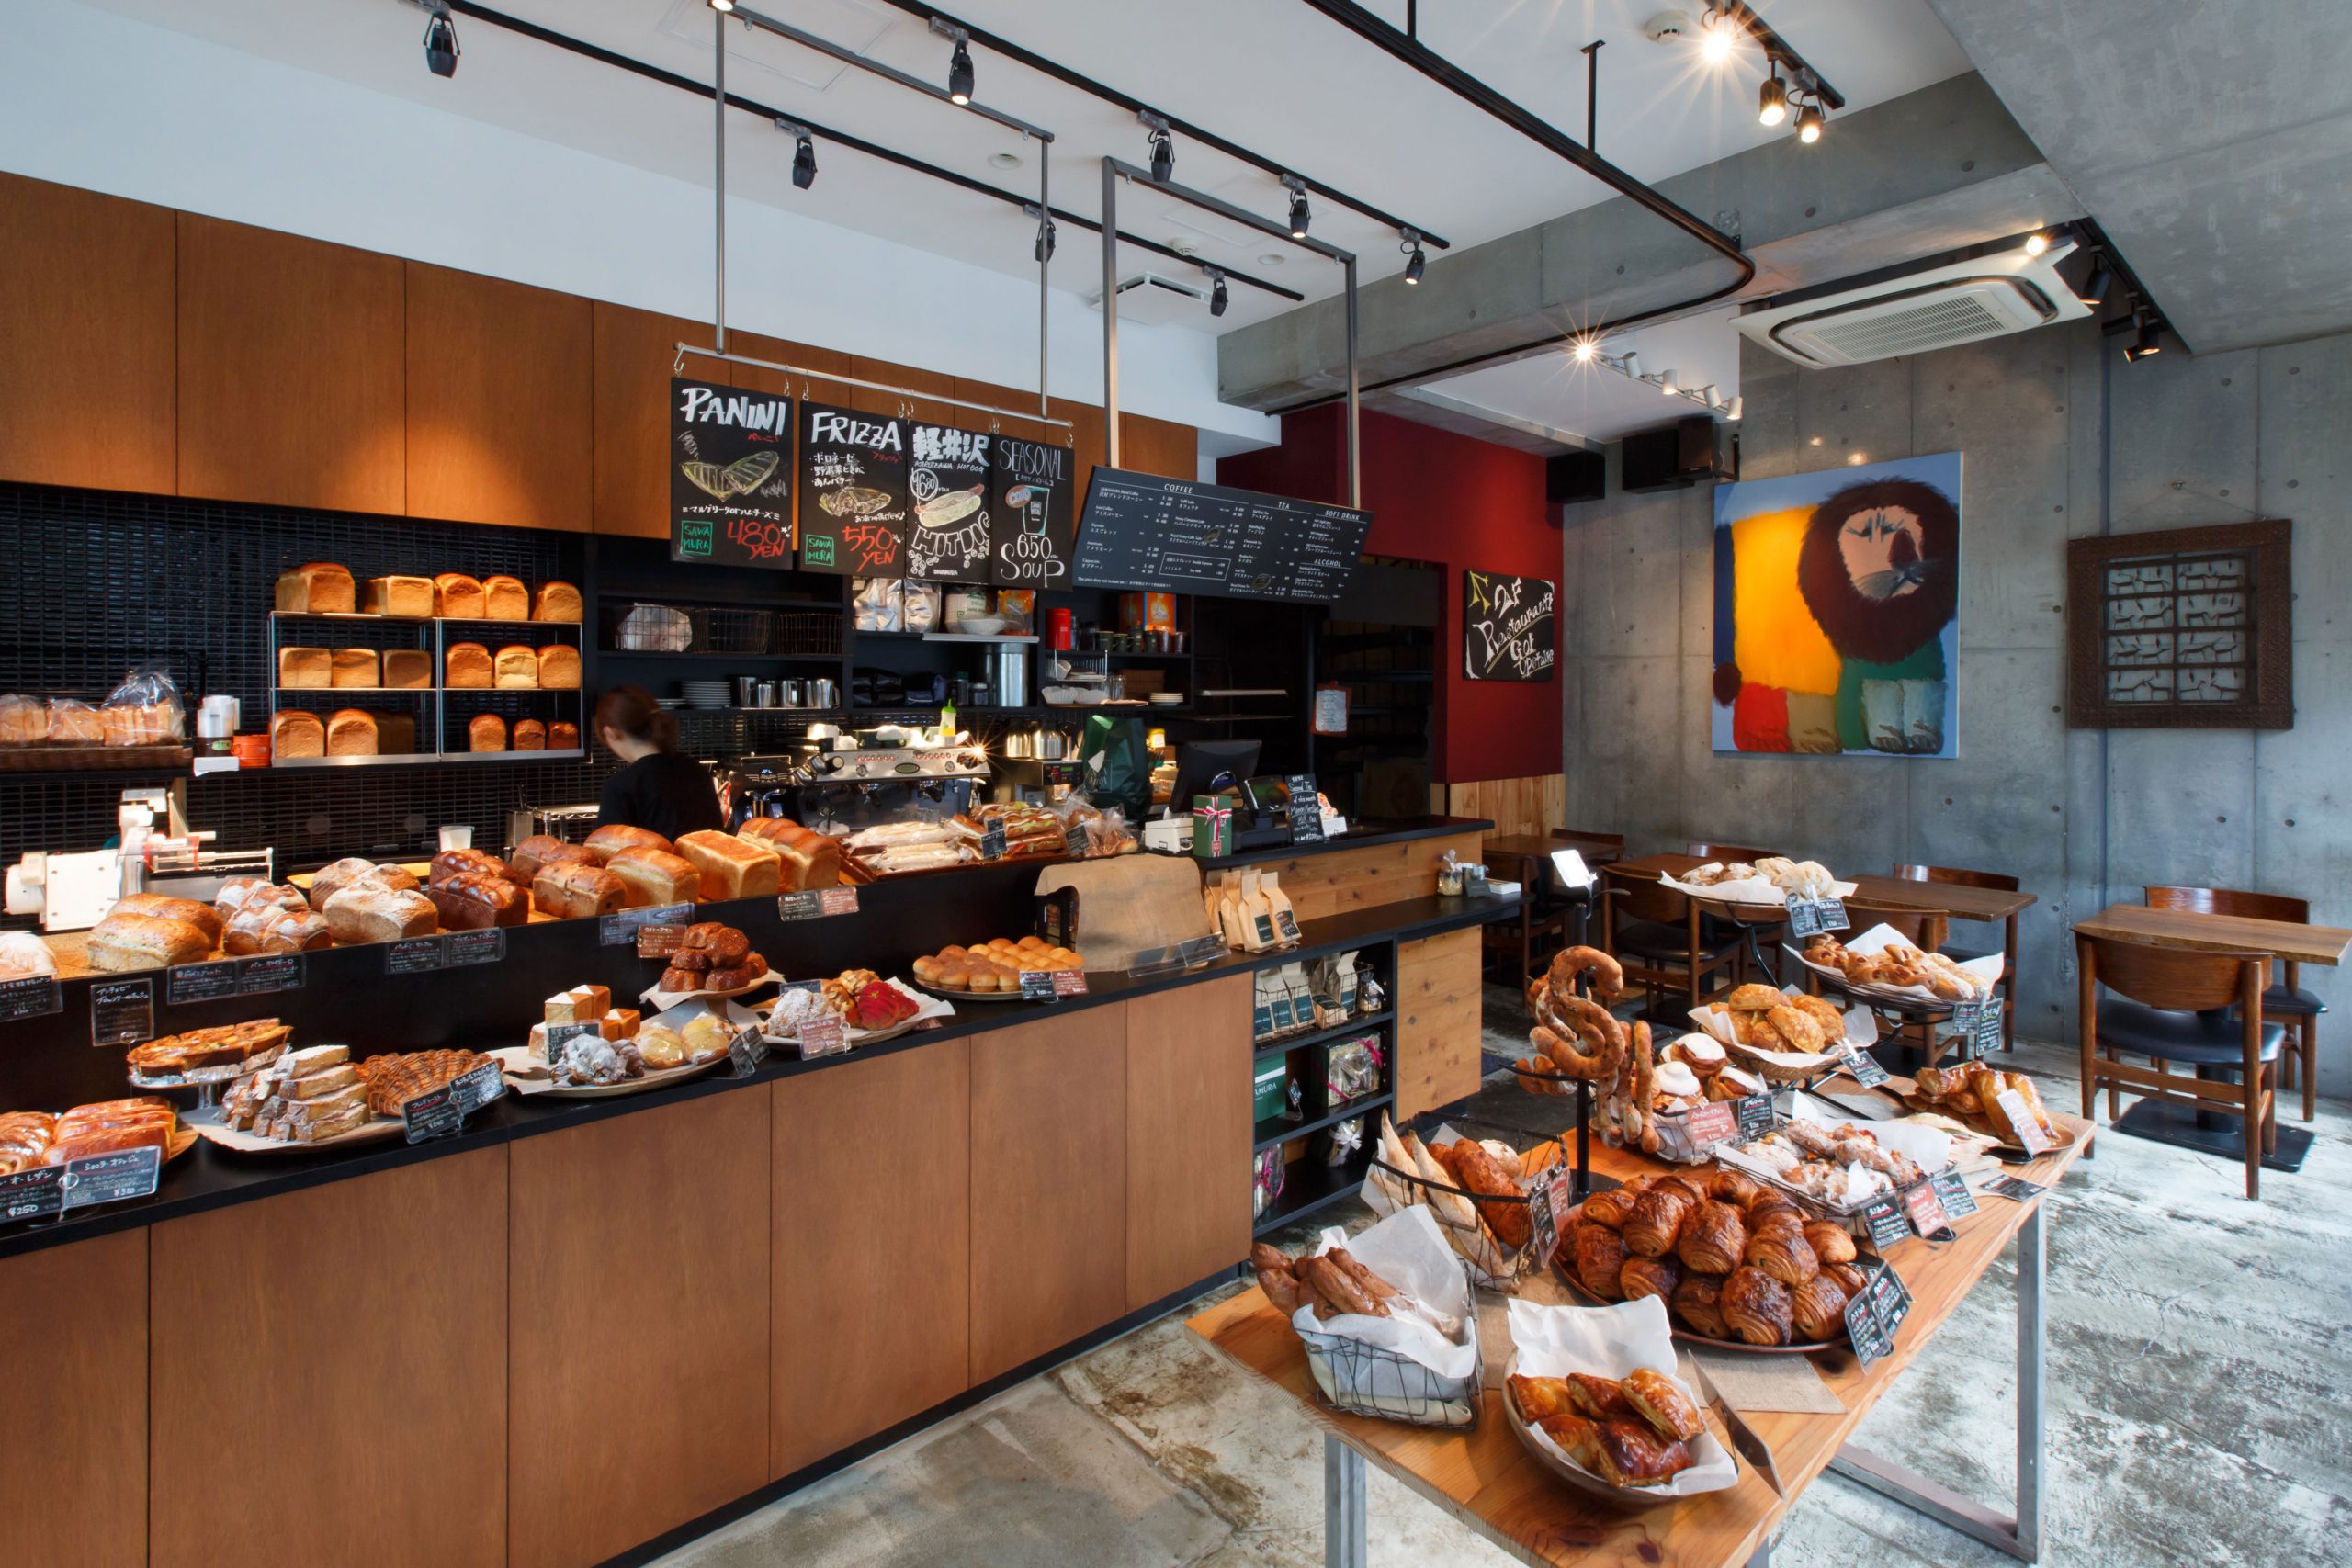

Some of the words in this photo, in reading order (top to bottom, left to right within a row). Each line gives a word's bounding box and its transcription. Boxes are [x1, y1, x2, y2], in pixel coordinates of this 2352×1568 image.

[679, 387, 786, 436] PANINI
[810, 412, 902, 451] FRIZZA
[912, 425, 990, 467] 軽井沢
[914, 460, 953, 470] KARUIZAWA
[1000, 440, 1066, 481] SEASONAL
[1164, 483, 1193, 494] COFFEE
[1278, 502, 1290, 510] TEA
[1325, 510, 1340, 518] SOFT
[1341, 512, 1361, 521] DRINK
[684, 525, 710, 536] SAWA
[727, 519, 781, 547] 480
[842, 525, 893, 551] 550
[683, 538, 709, 549] MURA
[749, 538, 786, 559] YEN
[808, 538, 831, 548] SAWA
[1017, 534, 1052, 559] 650
[808, 550, 831, 561] MURA
[856, 545, 897, 572] YEN
[1314, 558, 1341, 567] ALCOHOL
[1494, 577, 1521, 619] 2F
